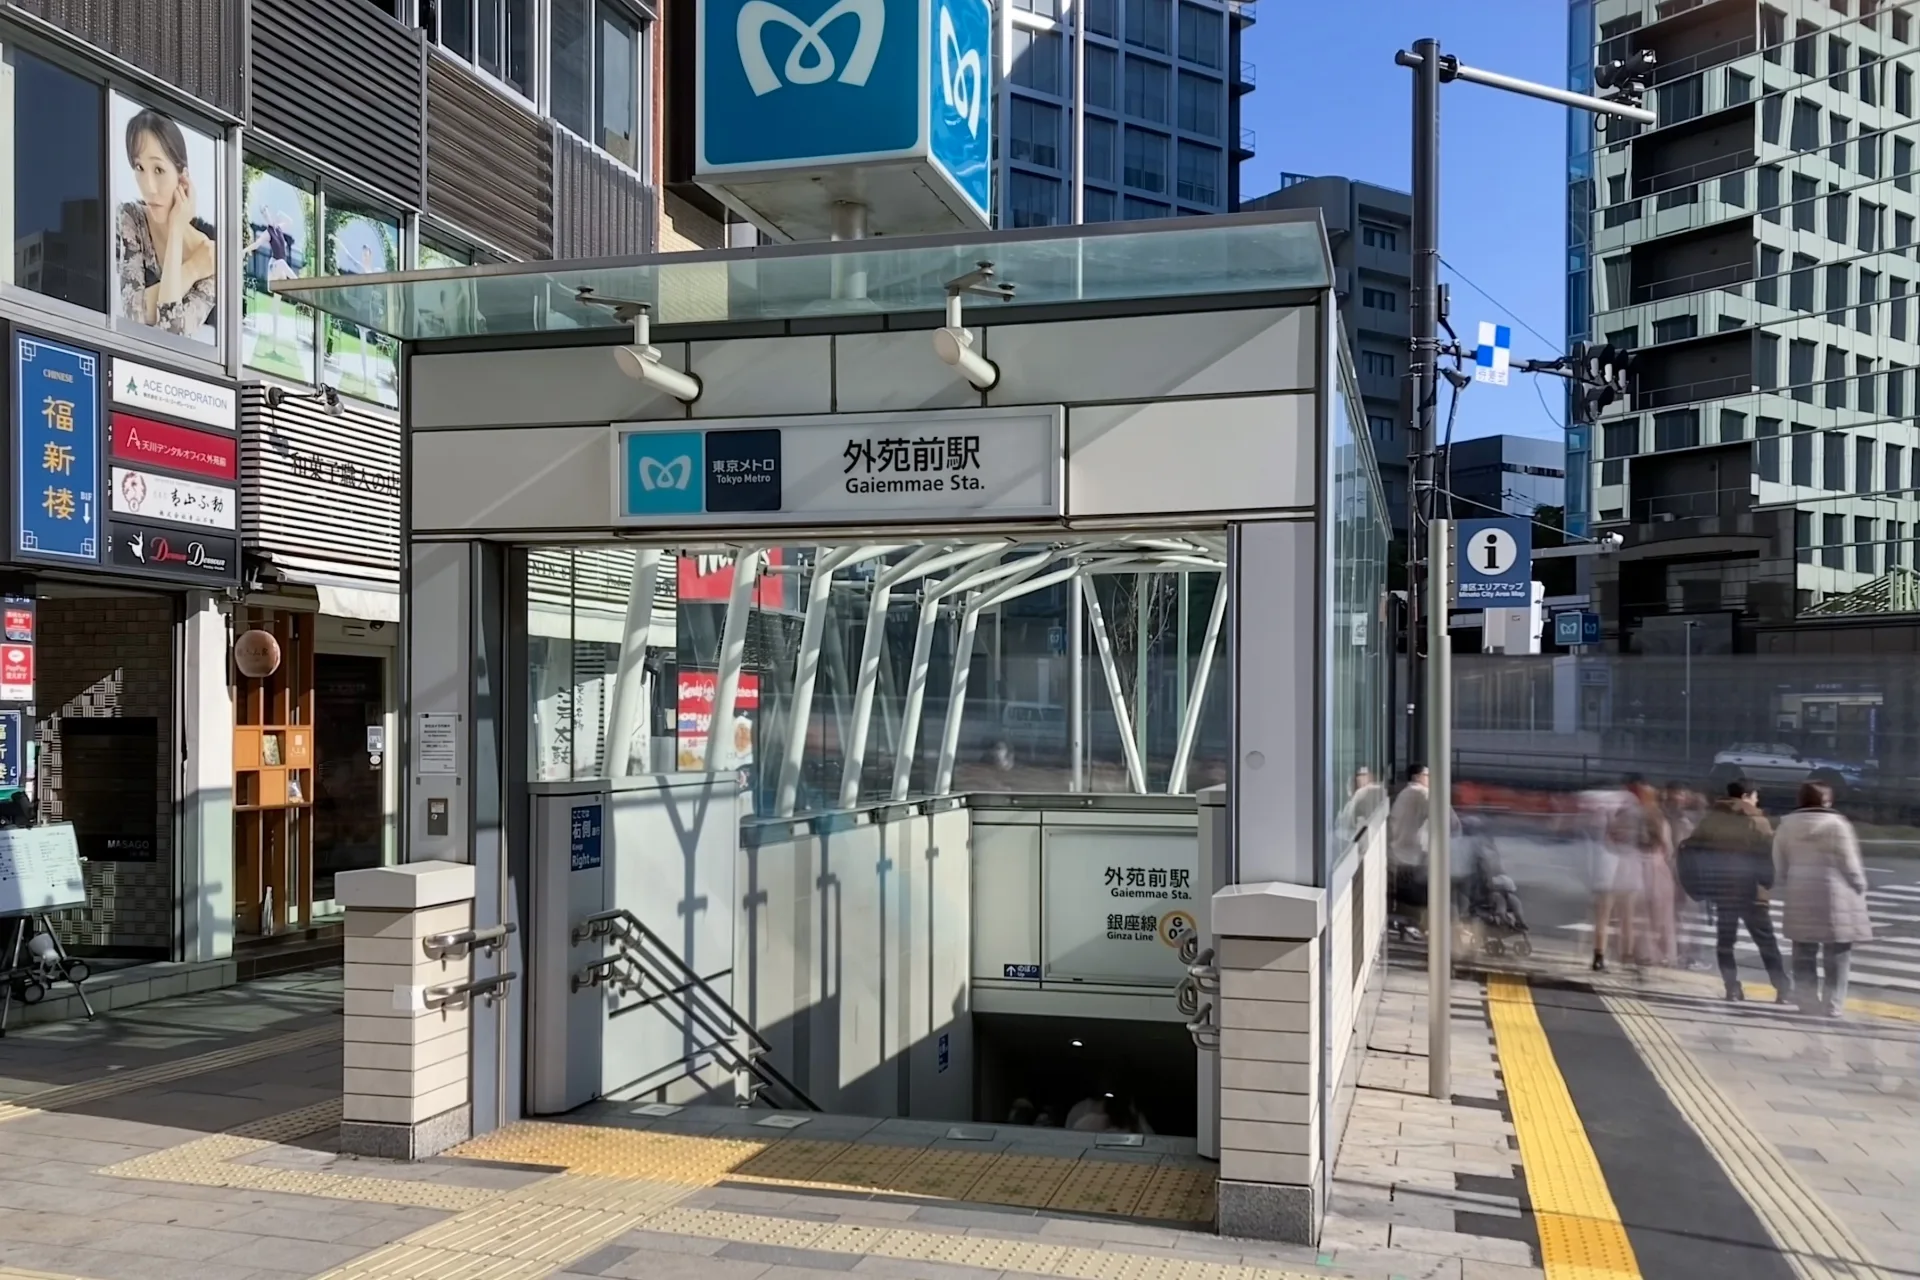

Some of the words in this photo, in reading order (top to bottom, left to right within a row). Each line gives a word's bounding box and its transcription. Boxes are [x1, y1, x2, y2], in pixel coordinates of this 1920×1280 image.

[43, 369, 74, 384] CHINESE
[143, 379, 163, 393] ACE
[164, 384, 228, 409] CORPORATION
[42, 395, 76, 521] 福新楼
[843, 436, 981, 475] 外苑前駅
[712, 459, 775, 473] 東京メトロ
[716, 474, 742, 485] Tokyo
[743, 473, 771, 484] Metro
[845, 474, 944, 494] Gaiemmae
[950, 474, 985, 491] Sta.
[1460, 582, 1524, 592] 港区エリアマップ
[107, 839, 150, 849] MASAGO
[571, 853, 590, 869] Right
[1104, 866, 1190, 888] 外苑前駅
[1111, 887, 1168, 899] Gaiemmae
[1171, 889, 1192, 900] Sta.
[1107, 913, 1157, 932] 銀座線
[1172, 916, 1183, 928] G
[1107, 931, 1132, 940] Ginza
[1135, 931, 1154, 941] Line
